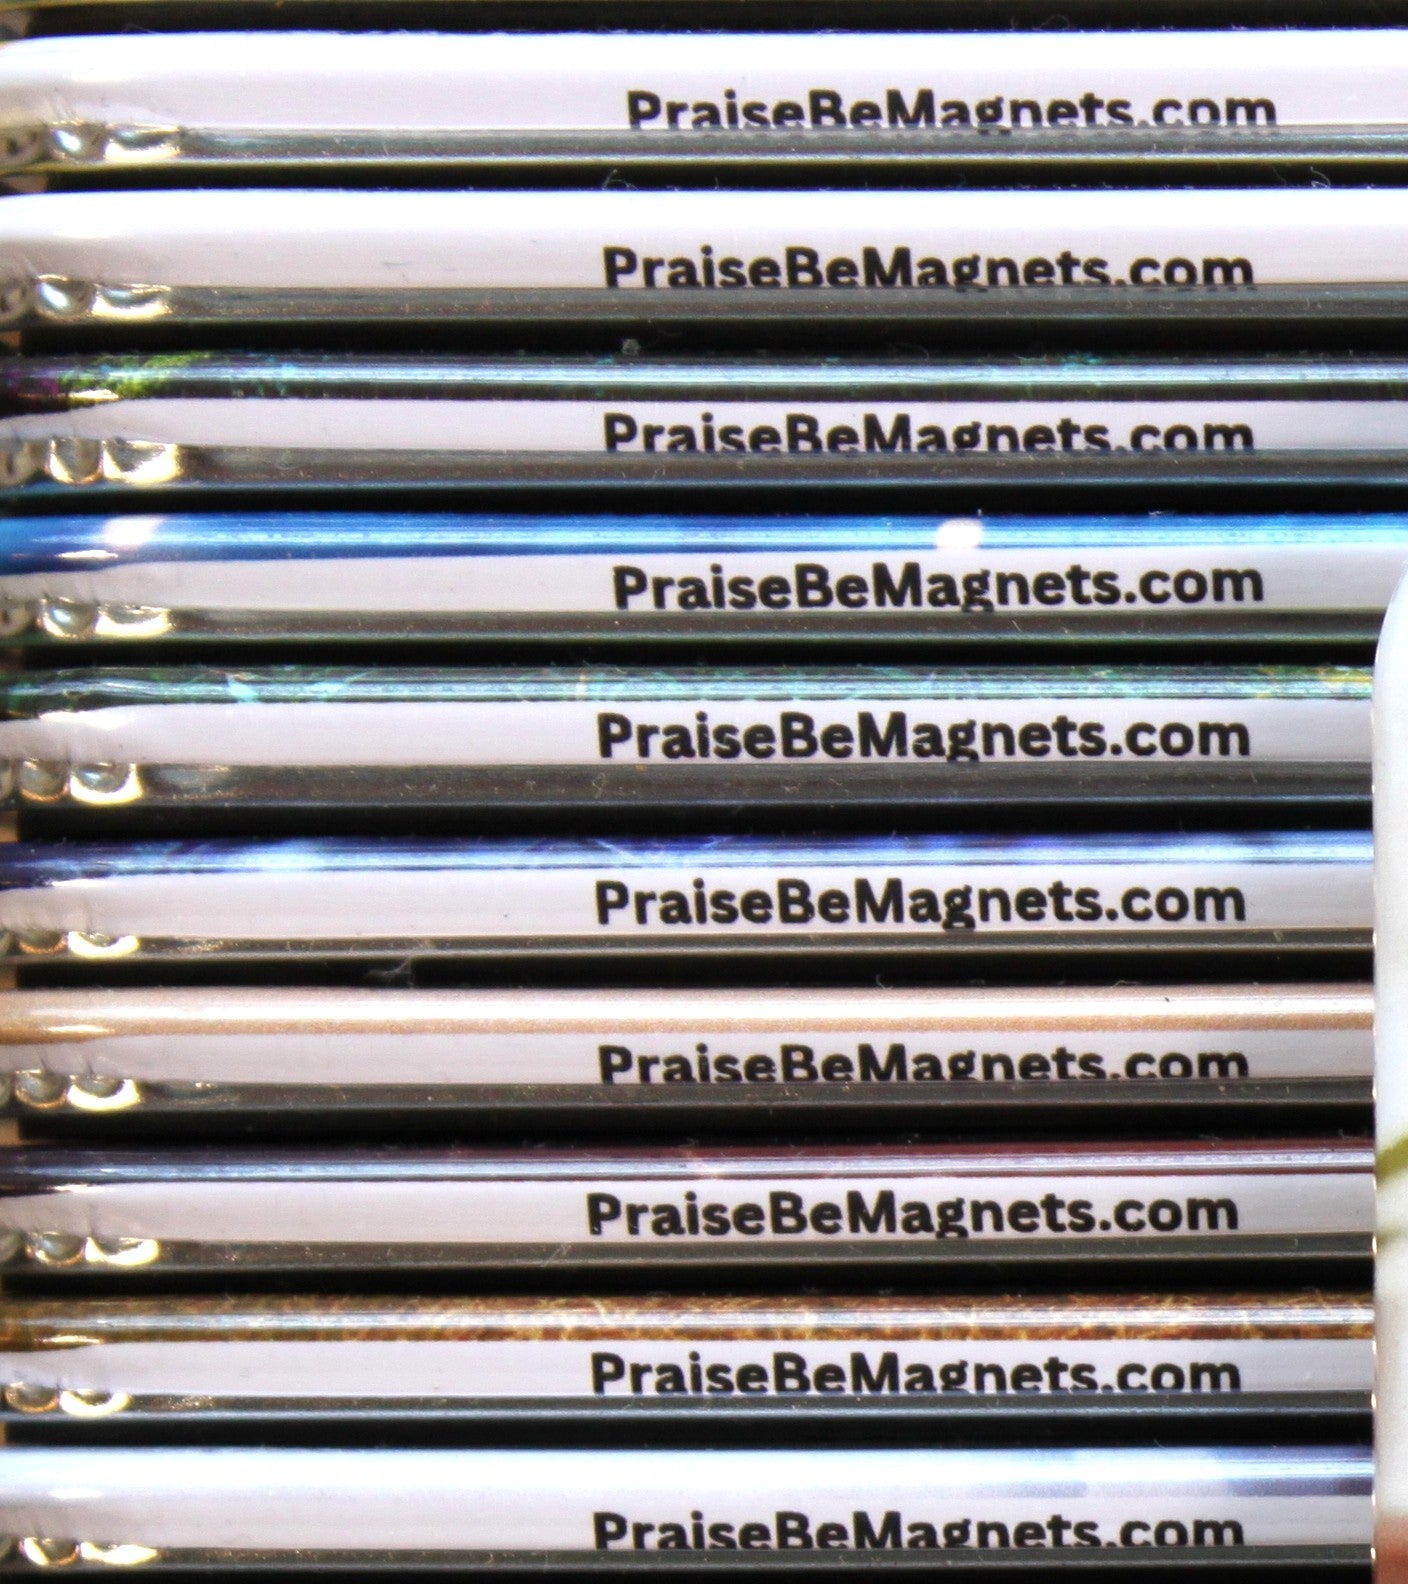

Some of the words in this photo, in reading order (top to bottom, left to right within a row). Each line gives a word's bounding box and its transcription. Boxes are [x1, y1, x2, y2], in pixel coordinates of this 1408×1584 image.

[627, 89, 1276, 132] PraiseBeMagnets.com
[604, 247, 1254, 290] PraiseBeMagnets.com
[604, 413, 1254, 454] PraiseBeMagnets.com
[613, 563, 1264, 612] PraiseBeMagnets.com
[598, 712, 1250, 763] PraiseBeMagnets.com
[596, 878, 1245, 931] PraiseBeMagnets.com
[600, 1044, 1250, 1084] PraiseBeMagnets.com
[587, 1191, 1238, 1239] PraiseBeMagnets.com
[592, 1351, 1242, 1395] PraiseBeMagnets.com
